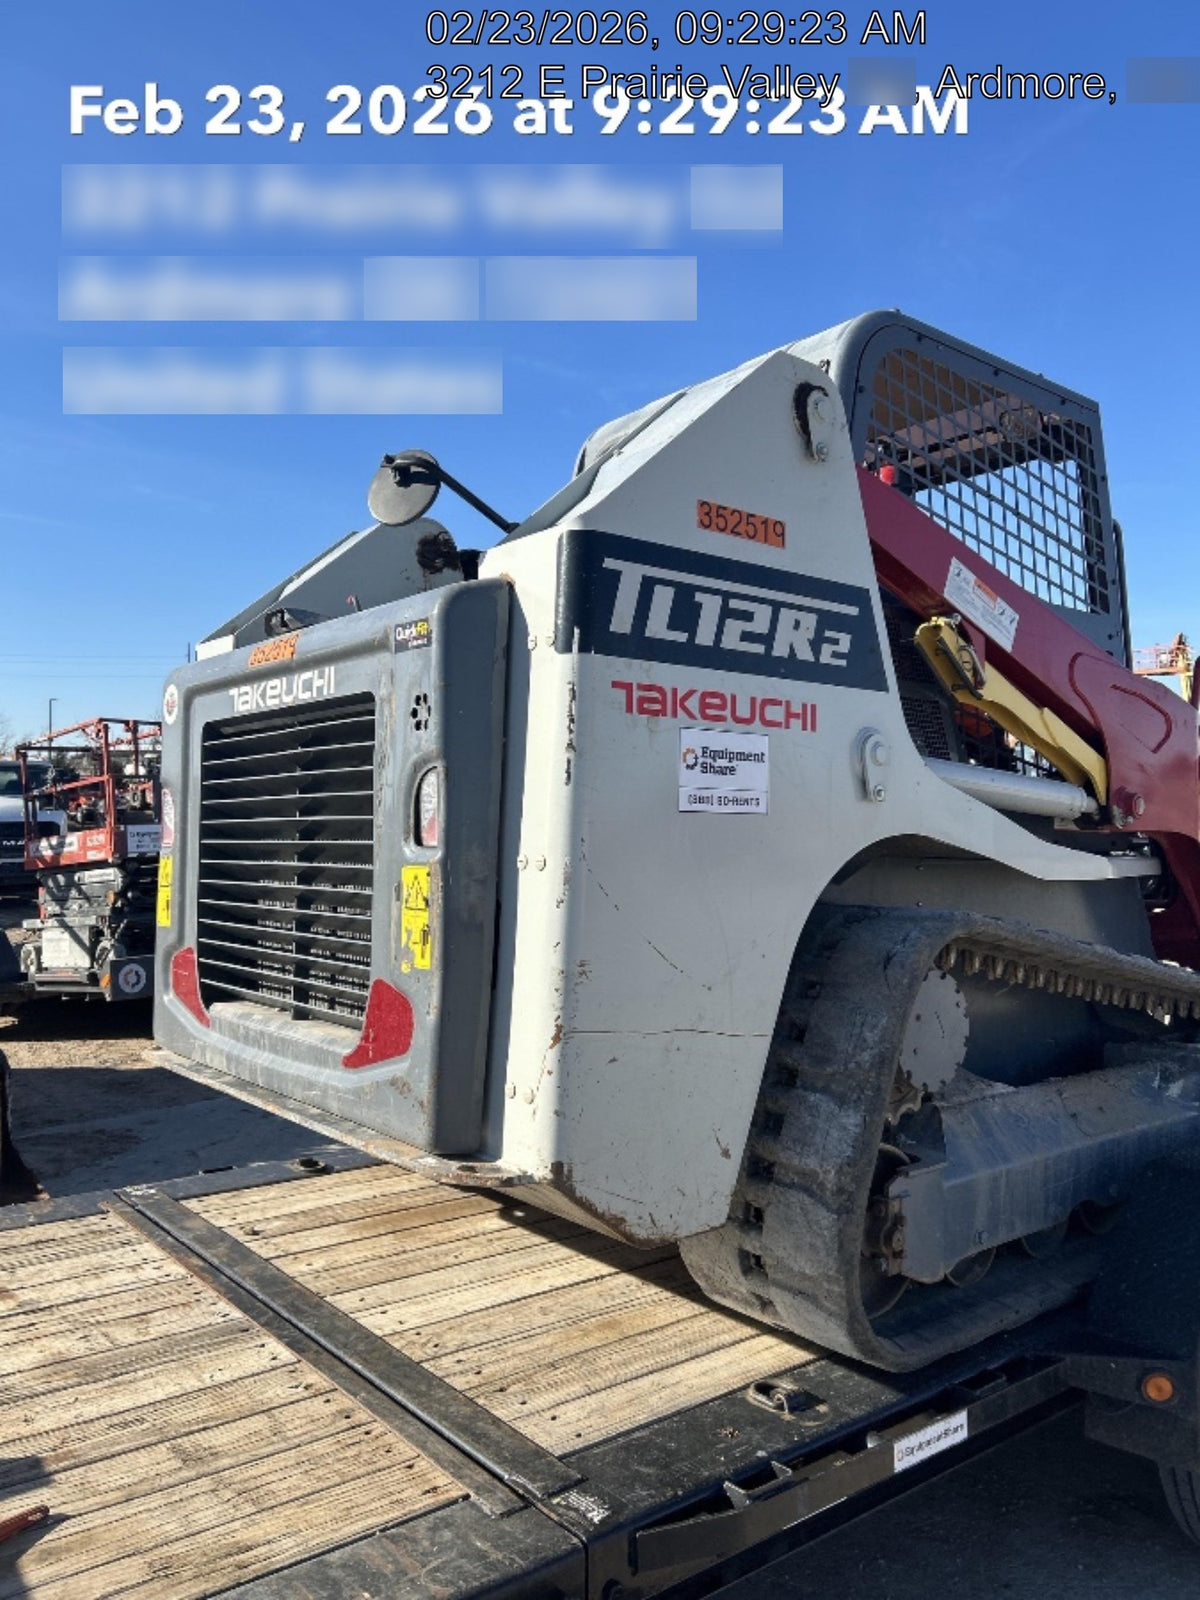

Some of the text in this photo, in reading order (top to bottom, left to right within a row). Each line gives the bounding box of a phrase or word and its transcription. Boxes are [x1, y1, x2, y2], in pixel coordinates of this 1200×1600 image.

[699, 500, 786, 547] 352519
[602, 557, 860, 667] TL12R2
[700, 746, 766, 763] Equipment
[700, 761, 737, 776] Share
